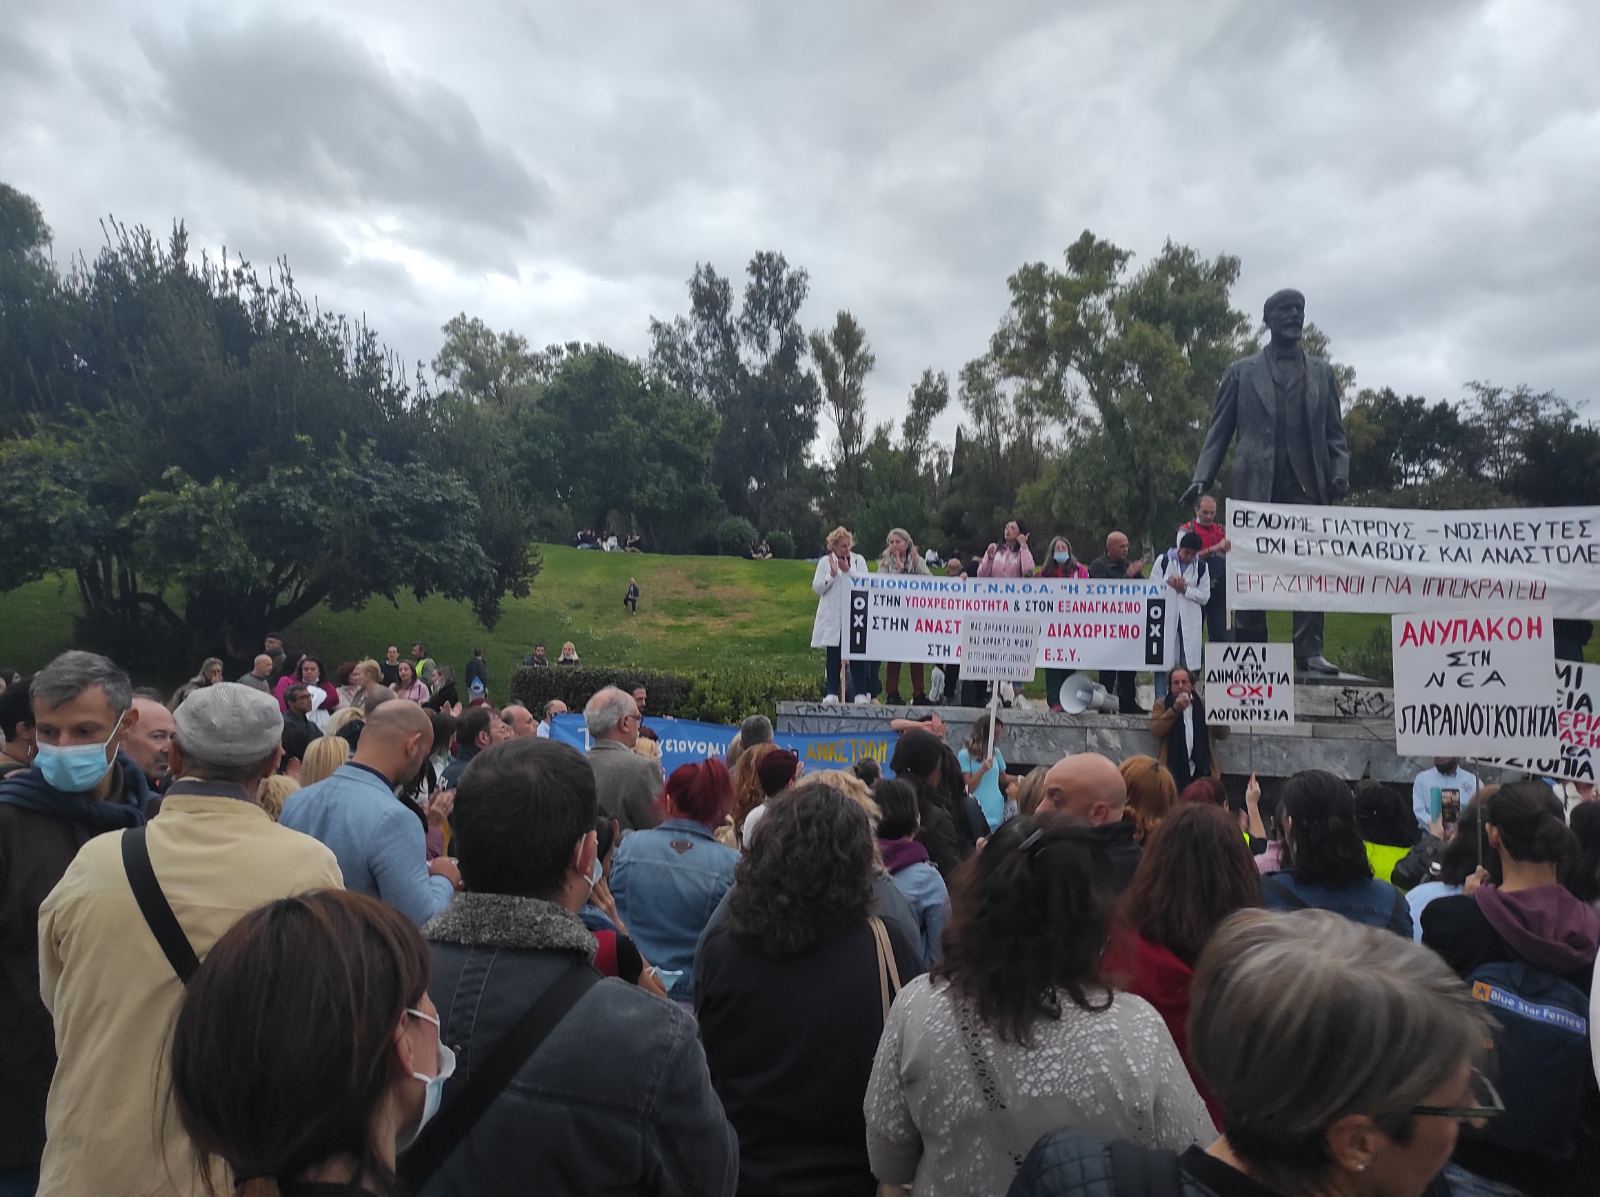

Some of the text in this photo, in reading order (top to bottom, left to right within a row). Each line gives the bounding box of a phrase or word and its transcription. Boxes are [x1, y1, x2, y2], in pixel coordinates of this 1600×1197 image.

[1233, 510, 1315, 533] ΘΕΛΟΥΜΕ
[1322, 518, 1416, 540] ΓΙΑΤΡΟΥΣ
[1443, 520, 1592, 542] ΝΟΣΗΛΕΥΤΕΣ
[1256, 536, 1286, 555] ΟΧΙ
[1294, 539, 1430, 563] ΕΡΓΟΛΑΒΟΥΣ
[1439, 546, 1472, 564] ΚΑΙ
[851, 577, 967, 592] ΥΓΕΙΟΝΟΜΙΚΟΙ
[973, 583, 1054, 595] Γ.Ν.Ν.Θ.Α.
[1236, 573, 1547, 600] ΕΡΓΑΖΟΜΕΝΟΙ ΓΝΑ ΙΠΠΟΚΡΑΤΕΙΟ
[873, 594, 1141, 614] ΣΤΗΝ ΥΠΟΧΡΕΩΤΙΚΟΤΗΤΑ & ΣΤΟΝ ΕΞΑΝΑΓΚΑΣΜΟ
[872, 616, 909, 632] ΣΤΗΝ
[1047, 623, 1141, 639] ΔΙΑΧΩΡΙΣΜΟ
[1399, 616, 1543, 648] ΑΝΥΠΑΚΟΗ
[928, 644, 951, 657] ΣΤΗ
[1044, 648, 1081, 662] Ε.Σ.Υ.
[1223, 646, 1266, 663] ΝΑΙ
[1446, 650, 1491, 667] ΣΤΗ
[1206, 669, 1290, 685] ΔΗΜΟΚΡΑΤΙΑ
[1424, 670, 1506, 688] ΝΕΑ
[1226, 684, 1273, 699] ΟΧΙ
[1207, 708, 1289, 722] ΛΟΓΟΚΡΙΣΙΑ
[1399, 702, 1557, 738] ΠΑΡΑΝΟΪΚΟΤΗΤΑ
[1490, 991, 1582, 1029] Blue Star Ferries
